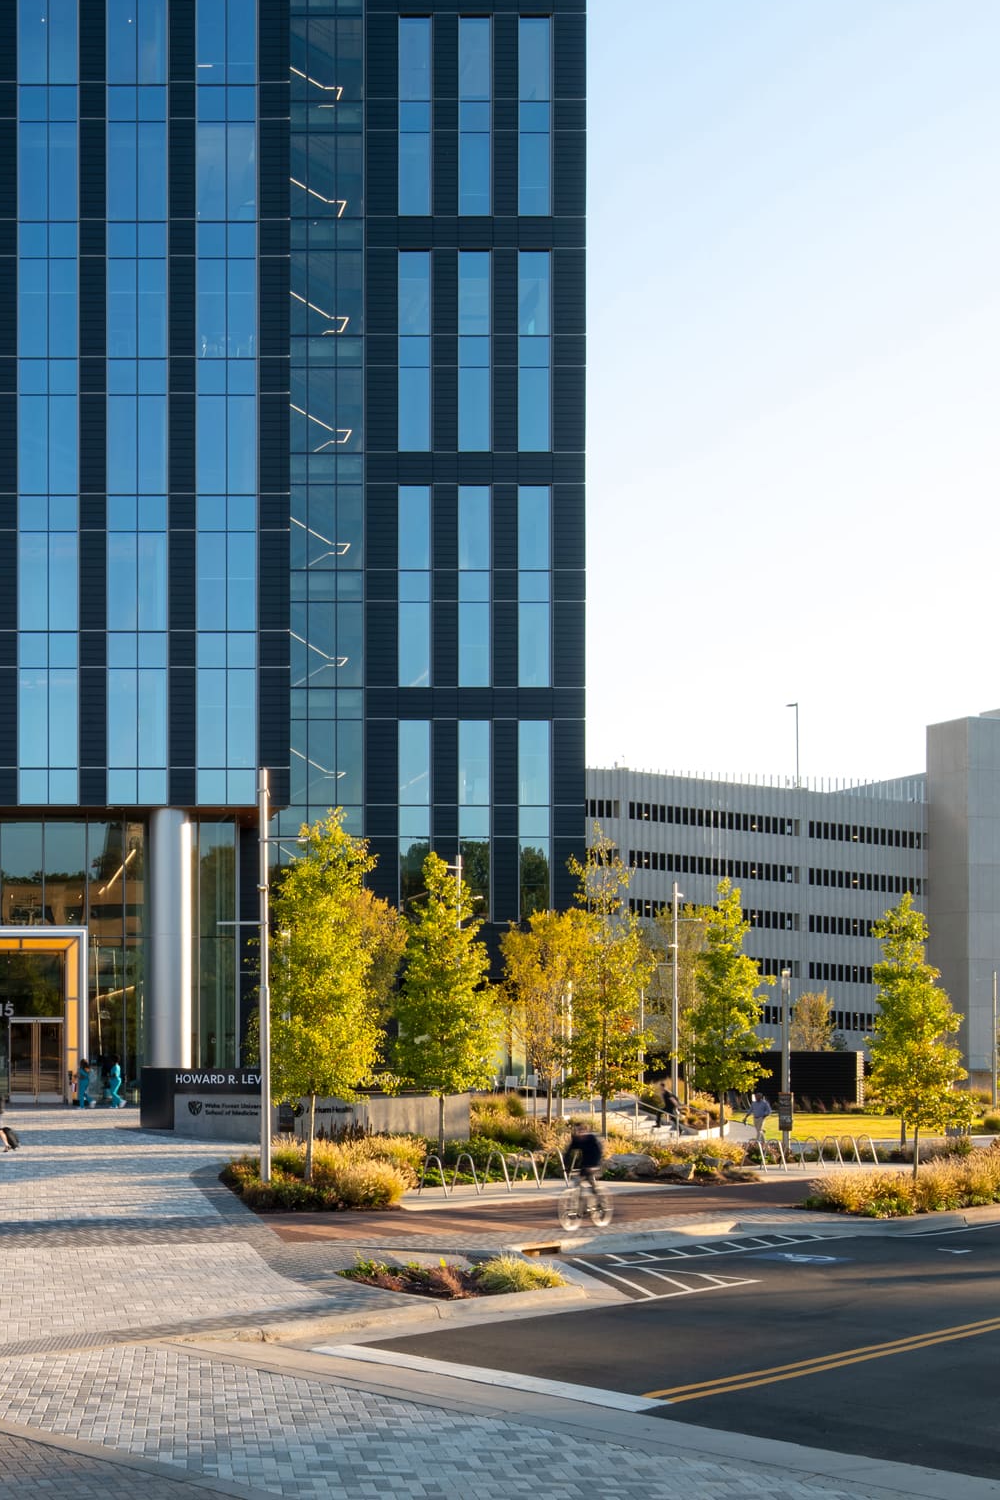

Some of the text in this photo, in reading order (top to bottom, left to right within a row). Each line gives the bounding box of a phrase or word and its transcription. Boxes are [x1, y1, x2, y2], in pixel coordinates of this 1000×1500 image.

[175, 1074, 225, 1084] HOWARD
[228, 1074, 239, 1084] R.
[332, 1105, 353, 1113] Health
